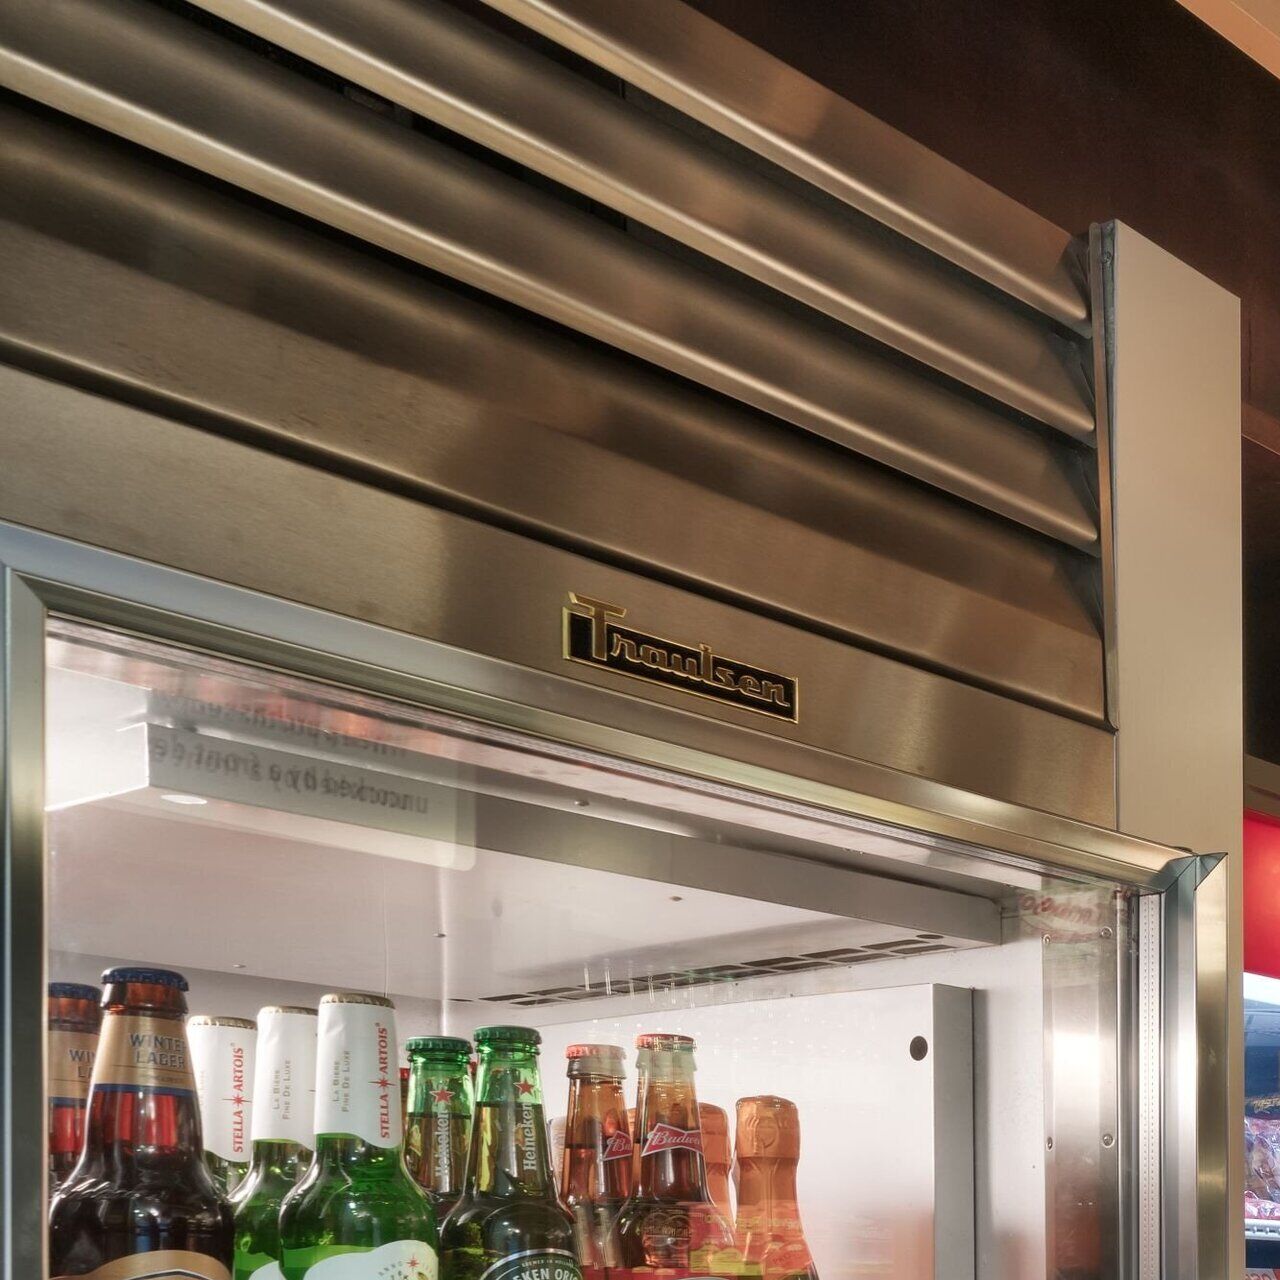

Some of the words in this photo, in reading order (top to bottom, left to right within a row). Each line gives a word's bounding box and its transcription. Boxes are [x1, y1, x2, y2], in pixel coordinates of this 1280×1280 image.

[568, 591, 790, 707] Traulsen
[233, 1047, 245, 1092] ARTOIS
[378, 1027, 389, 1075] ARTOIS
[233, 1110, 246, 1153] STELLA
[379, 1094, 390, 1139] STELLA
[522, 1105, 535, 1171] Heineken
